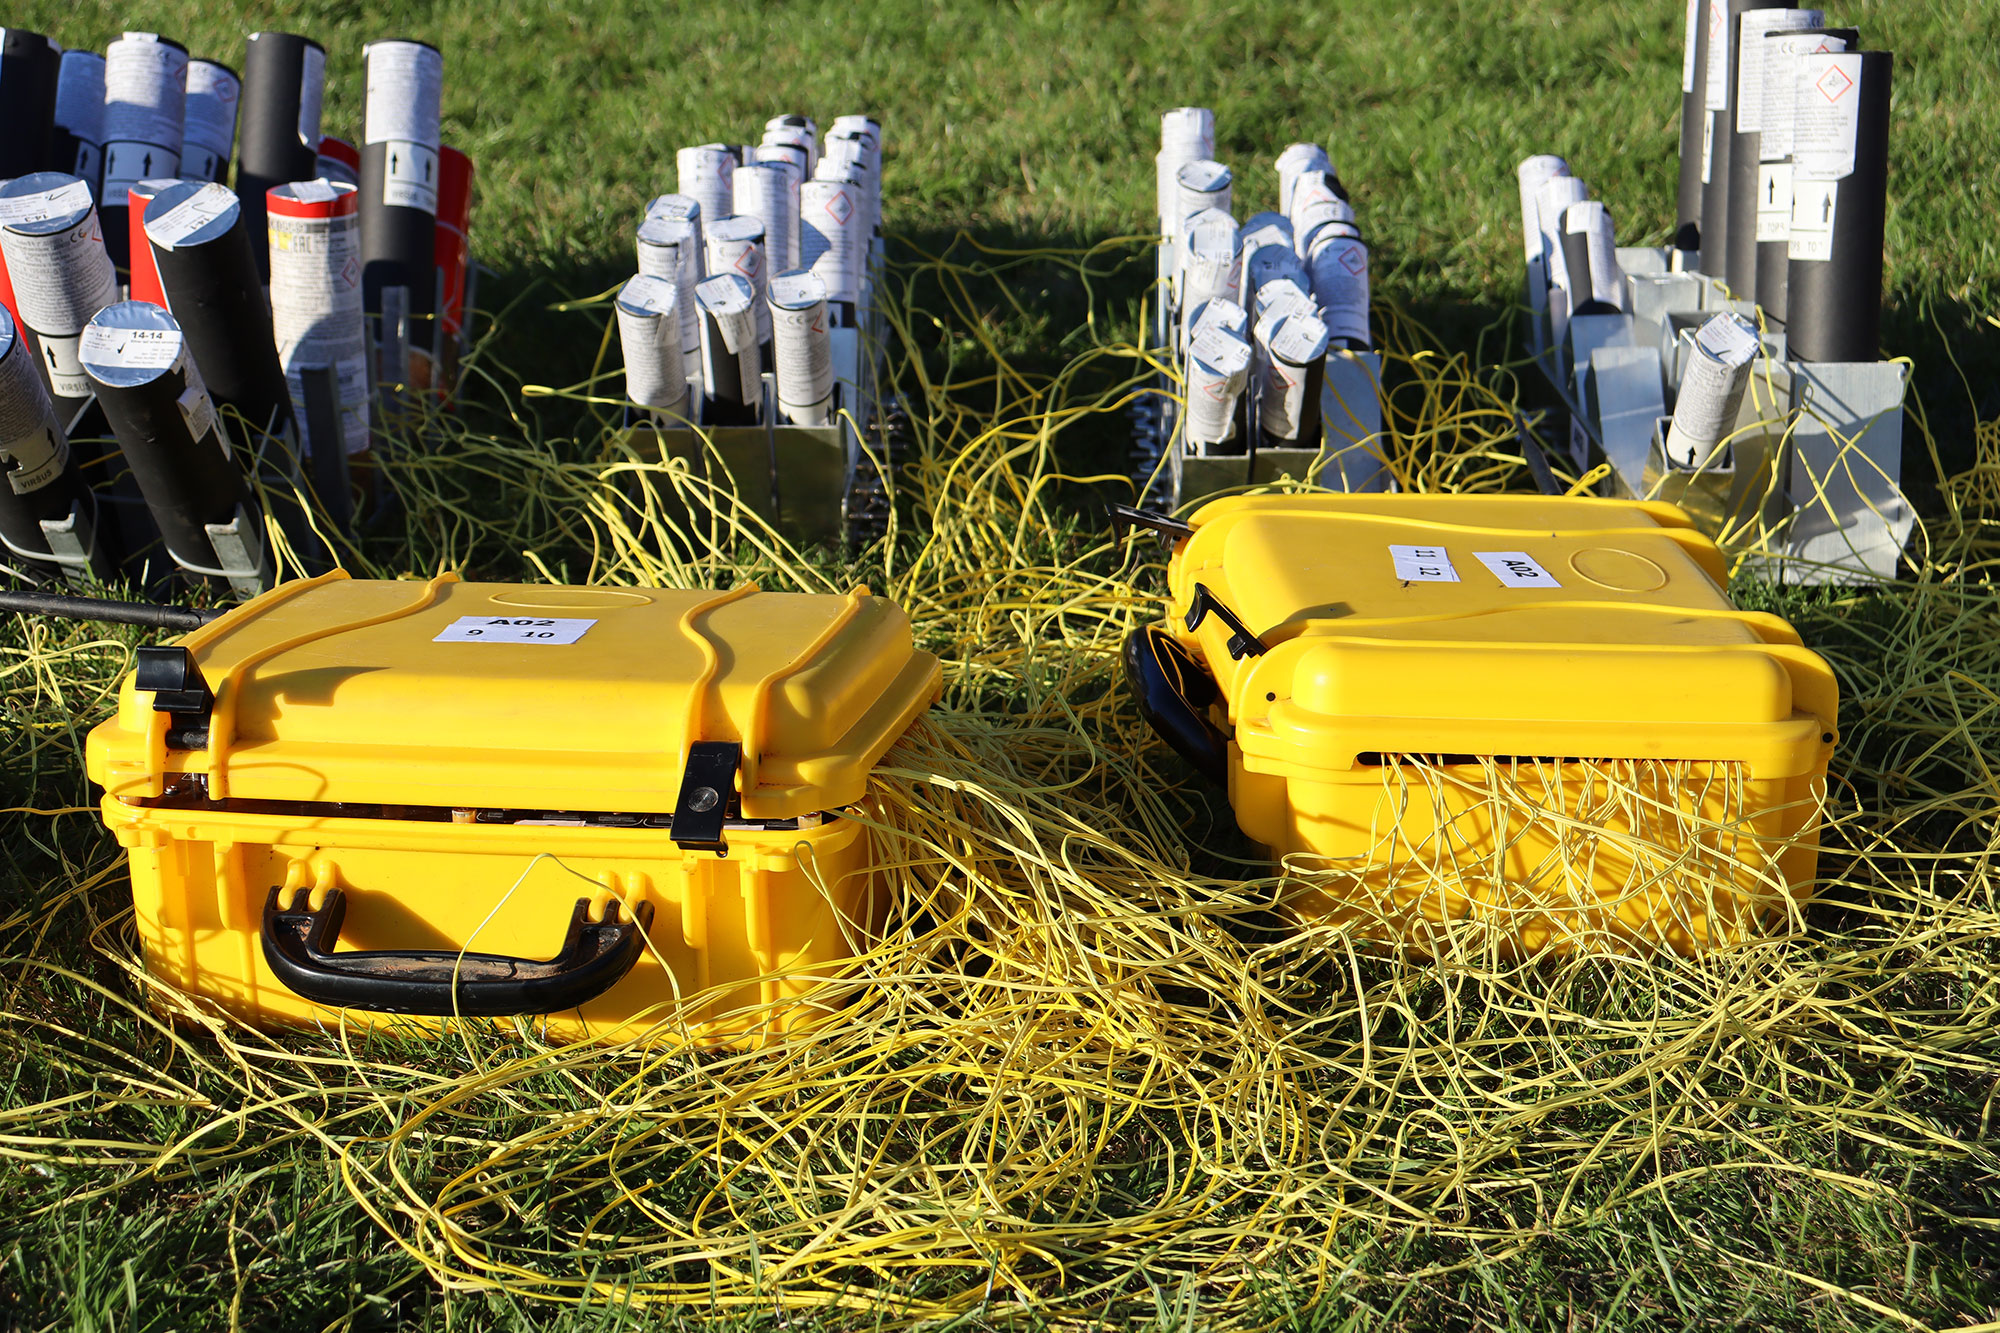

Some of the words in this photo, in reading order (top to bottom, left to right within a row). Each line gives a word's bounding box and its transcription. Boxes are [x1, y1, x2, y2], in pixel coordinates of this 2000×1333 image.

[132, 331, 163, 339] 14-14
[20, 469, 53, 489] VIRŠUS
[1415, 549, 1436, 558] 11
[1419, 566, 1441, 576] 12
[1501, 559, 1539, 578] A02
[487, 619, 556, 627] A02
[520, 631, 555, 639] 10
